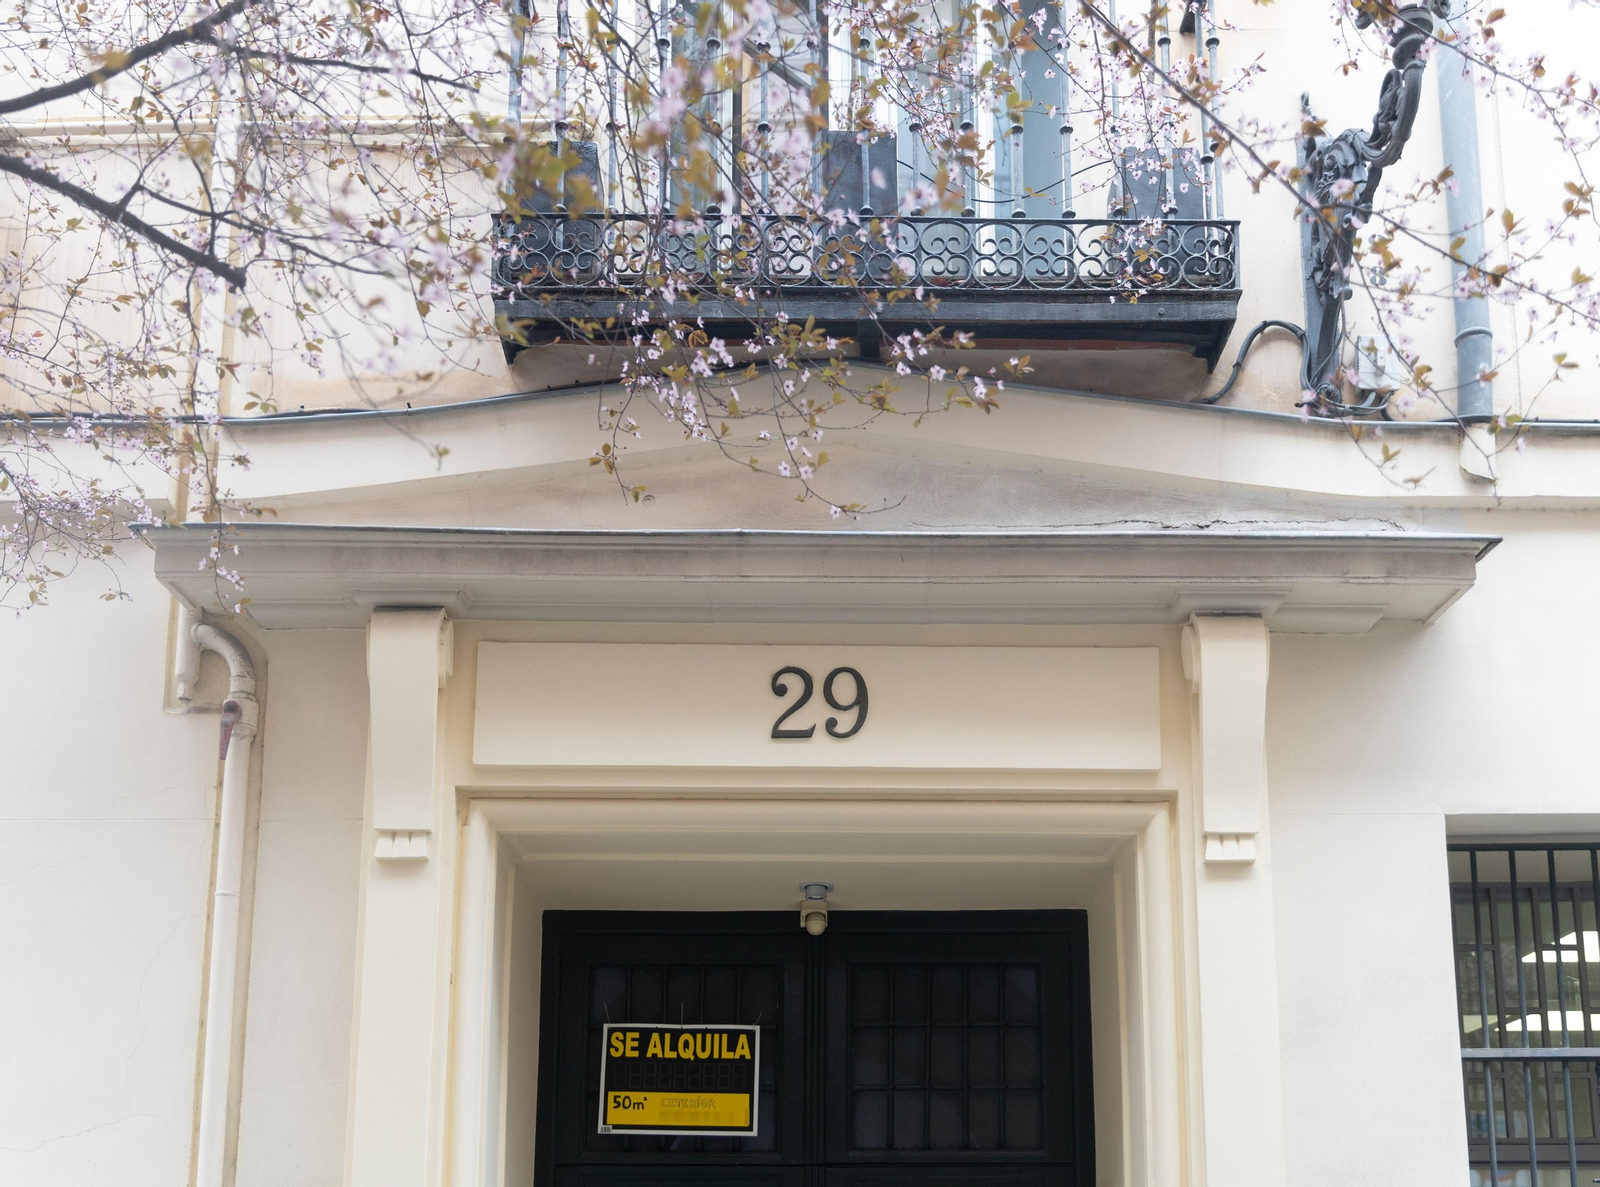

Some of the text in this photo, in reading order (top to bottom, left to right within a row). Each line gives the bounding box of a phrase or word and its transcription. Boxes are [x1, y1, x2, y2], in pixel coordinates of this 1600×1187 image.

[771, 666, 869, 738] 29
[610, 1031, 751, 1061] SE ALQUILA
